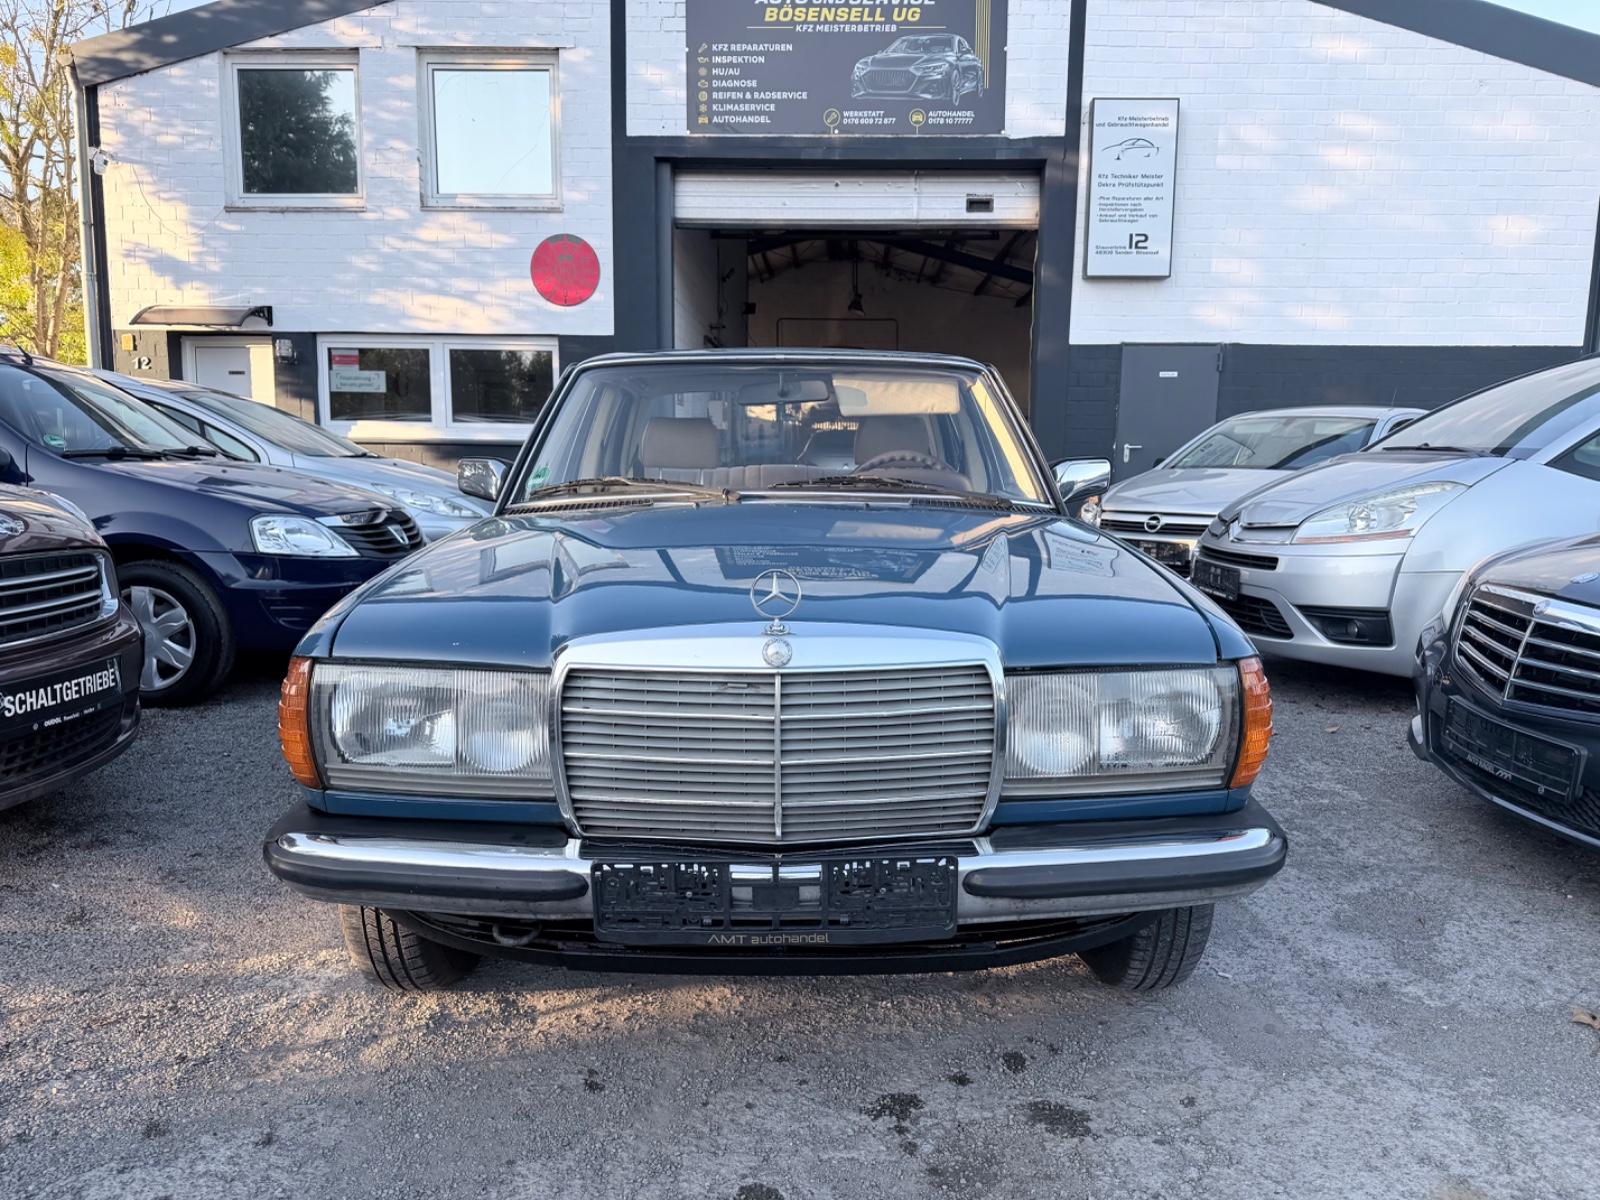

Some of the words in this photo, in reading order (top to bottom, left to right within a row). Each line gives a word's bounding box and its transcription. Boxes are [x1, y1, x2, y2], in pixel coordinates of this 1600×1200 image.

[764, 4, 885, 22] BÖSENSELL
[892, 7, 921, 22] UG
[796, 24, 814, 32] KFZ
[815, 24, 897, 32] MEISTERBETRIEB
[712, 43, 729, 52] KFZ
[730, 43, 793, 52] REPARATUREN
[712, 55, 765, 64] INSPEKTION
[712, 67, 741, 76] HU/AU
[712, 79, 758, 88] DIAGNOSE
[712, 91, 743, 100] REIFEN
[744, 91, 752, 100] &
[753, 91, 808, 100] RADSERVICE
[712, 103, 776, 112] KLIMASERVICE
[928, 110, 975, 118] AUTOHANDEL
[712, 115, 771, 124] AUTOHANDEL
[1128, 233, 1149, 250] 12
[132, 356, 150, 370] 12
[4, 668, 116, 717] SCHALTGETRIEBE
[707, 934, 747, 944] AMT
[751, 932, 829, 944] autohandel
